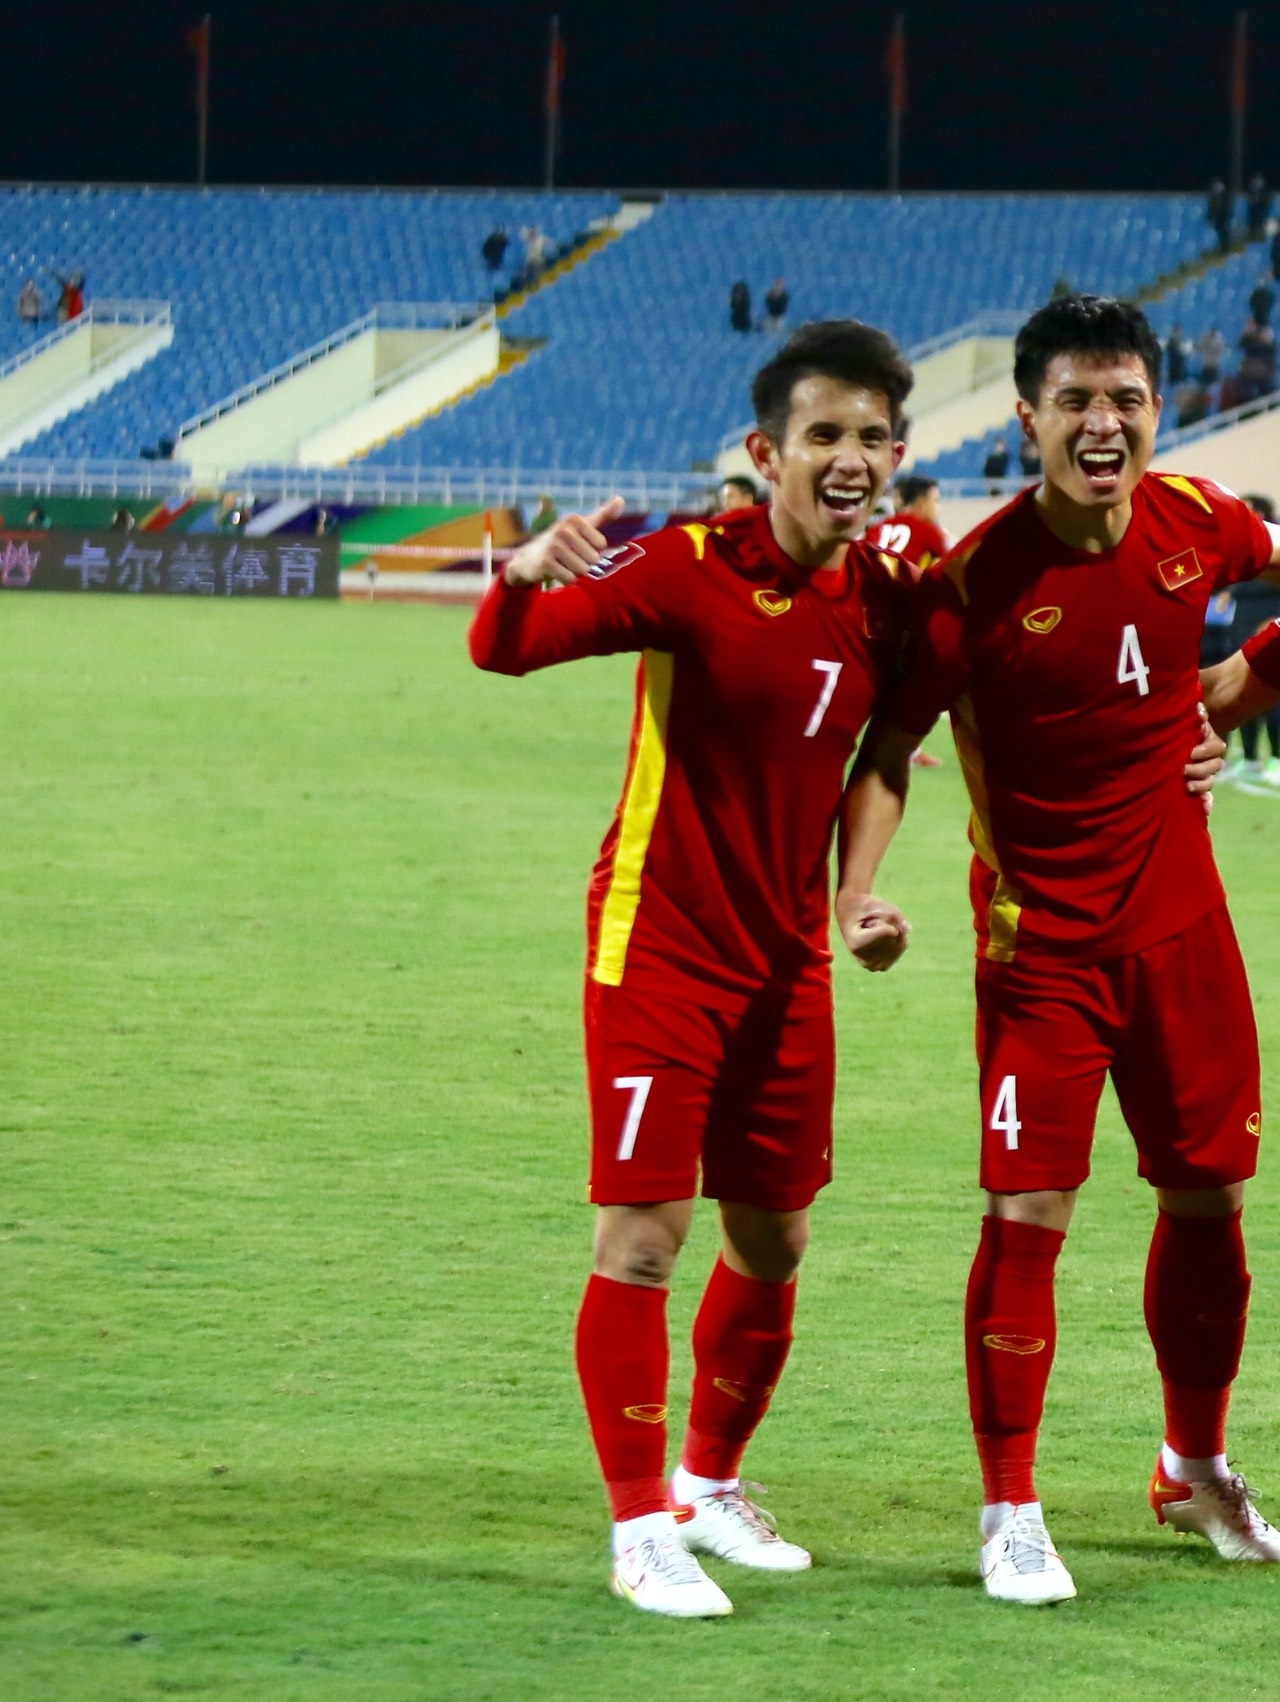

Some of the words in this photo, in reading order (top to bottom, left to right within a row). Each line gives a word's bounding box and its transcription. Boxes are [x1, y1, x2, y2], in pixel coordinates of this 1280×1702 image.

[62, 537, 322, 598] 卡尔美体育
[1116, 624, 1150, 696] 4
[803, 659, 843, 737] 7
[612, 1076, 654, 1161] 7
[990, 1075, 1022, 1150] 4
